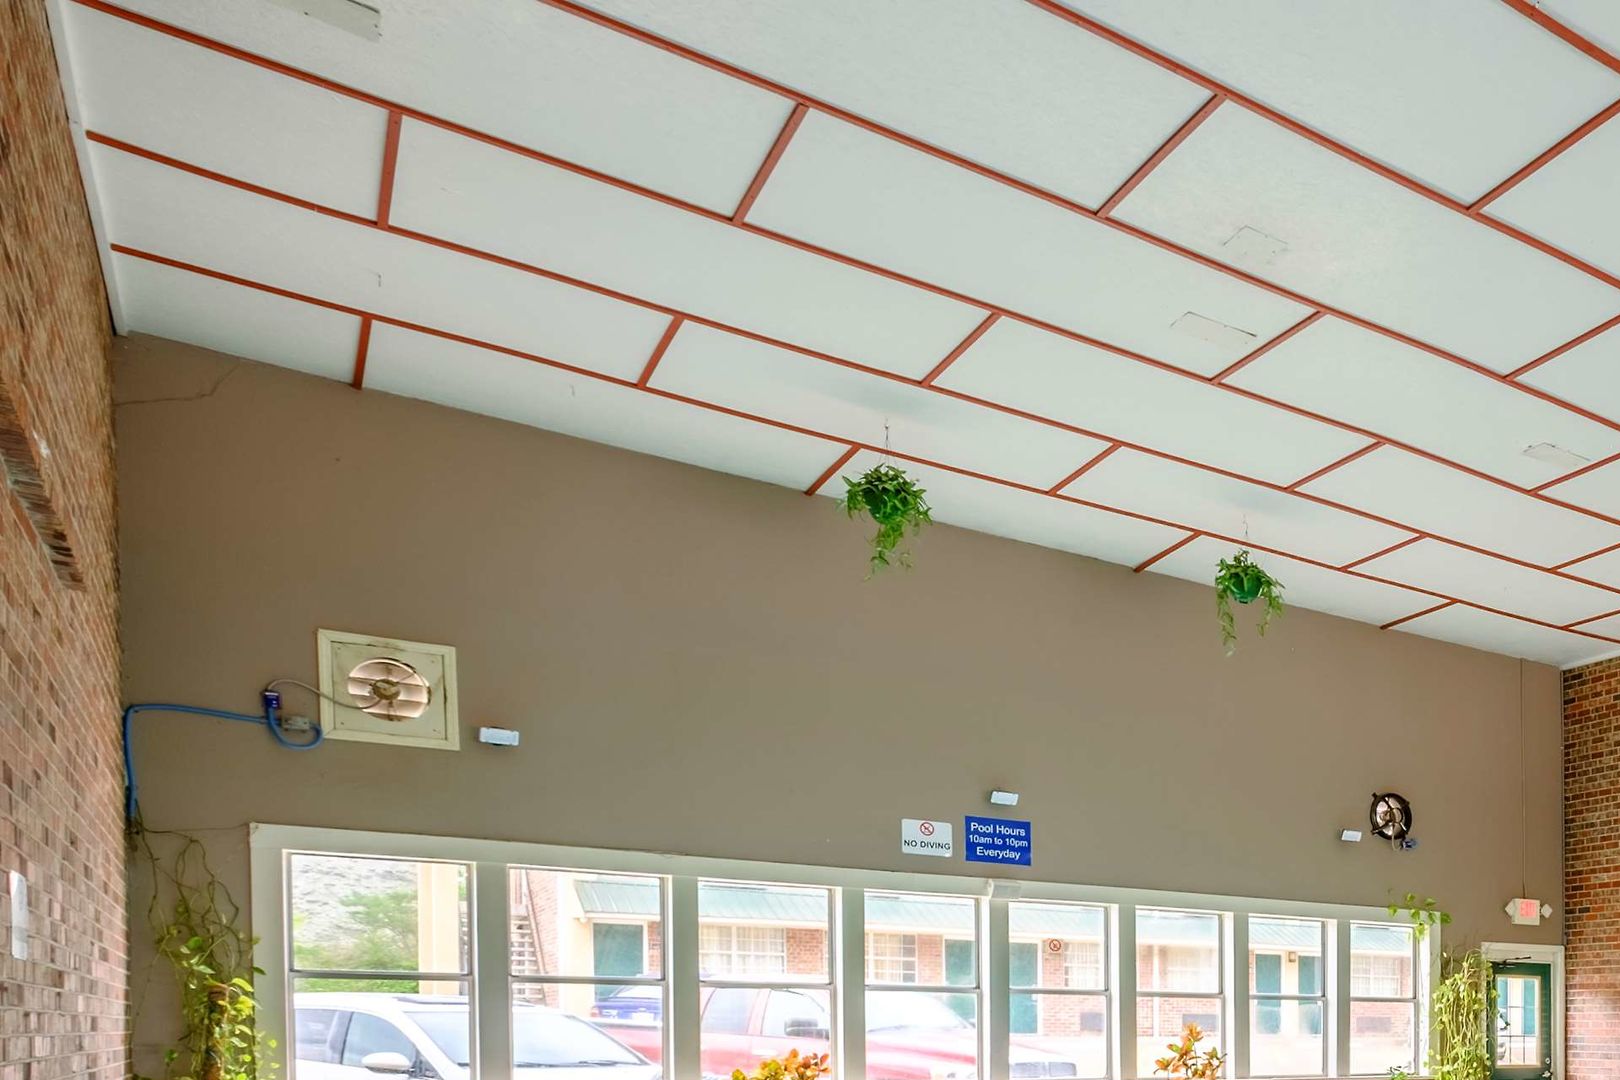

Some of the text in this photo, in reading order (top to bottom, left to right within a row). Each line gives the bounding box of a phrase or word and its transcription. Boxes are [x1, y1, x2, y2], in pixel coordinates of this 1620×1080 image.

[971, 822, 1026, 837] Pool Hours
[904, 839, 951, 851] NO DIVING
[969, 834, 1028, 848] 10am to 10pm
[976, 846, 1021, 861] Everyday
